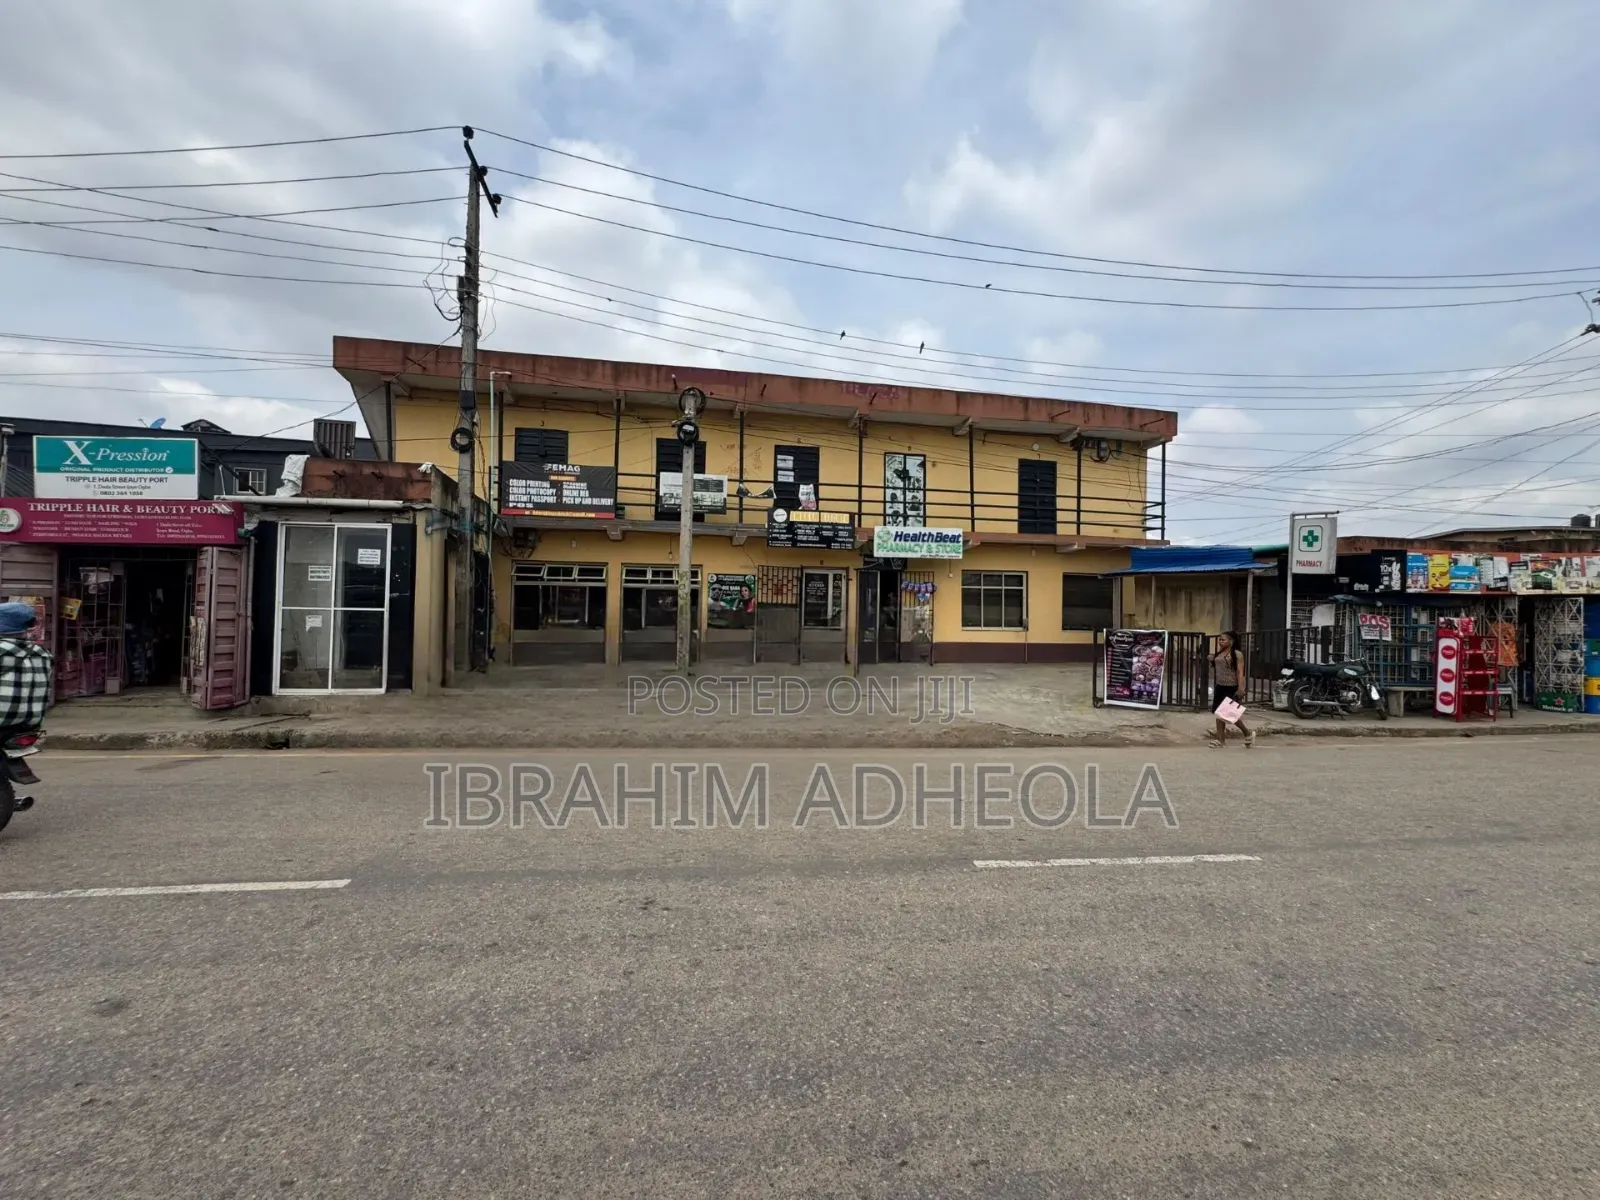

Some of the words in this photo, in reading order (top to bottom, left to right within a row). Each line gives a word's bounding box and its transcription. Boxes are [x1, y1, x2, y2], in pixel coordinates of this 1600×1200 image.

[62, 440, 168, 465] X-Pression
[28, 503, 83, 512] TRIPPLE
[87, 503, 119, 513] HAIR
[122, 504, 133, 513] &
[136, 505, 187, 514] BEAUTY
[893, 530, 962, 543] HealthBeat
[876, 542, 924, 553] PHARMACY
[927, 544, 933, 553] &
[935, 544, 962, 554] STORE
[1296, 560, 1322, 568] PHARMACY
